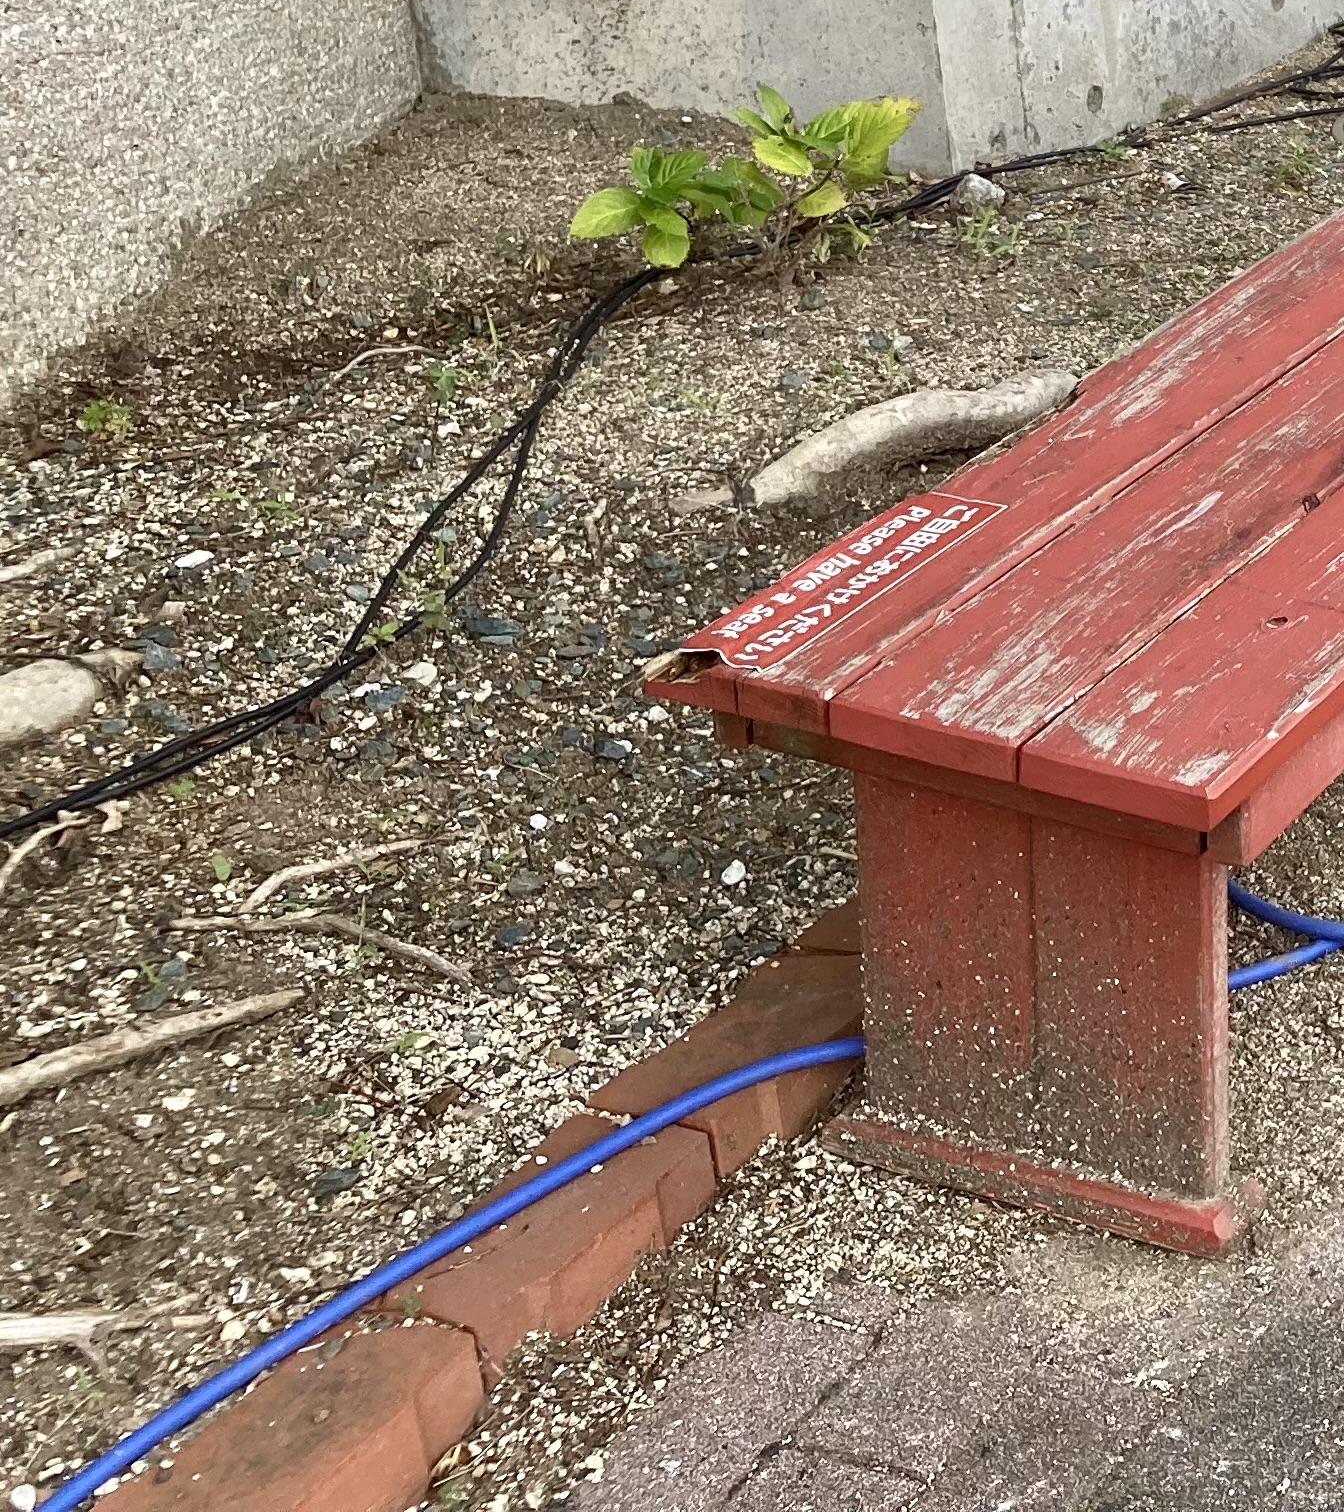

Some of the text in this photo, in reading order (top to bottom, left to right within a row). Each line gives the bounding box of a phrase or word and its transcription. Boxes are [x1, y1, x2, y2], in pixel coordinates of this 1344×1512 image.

[711, 505, 932, 639] Please have a seat
[735, 505, 979, 660] ご自由におかけください
